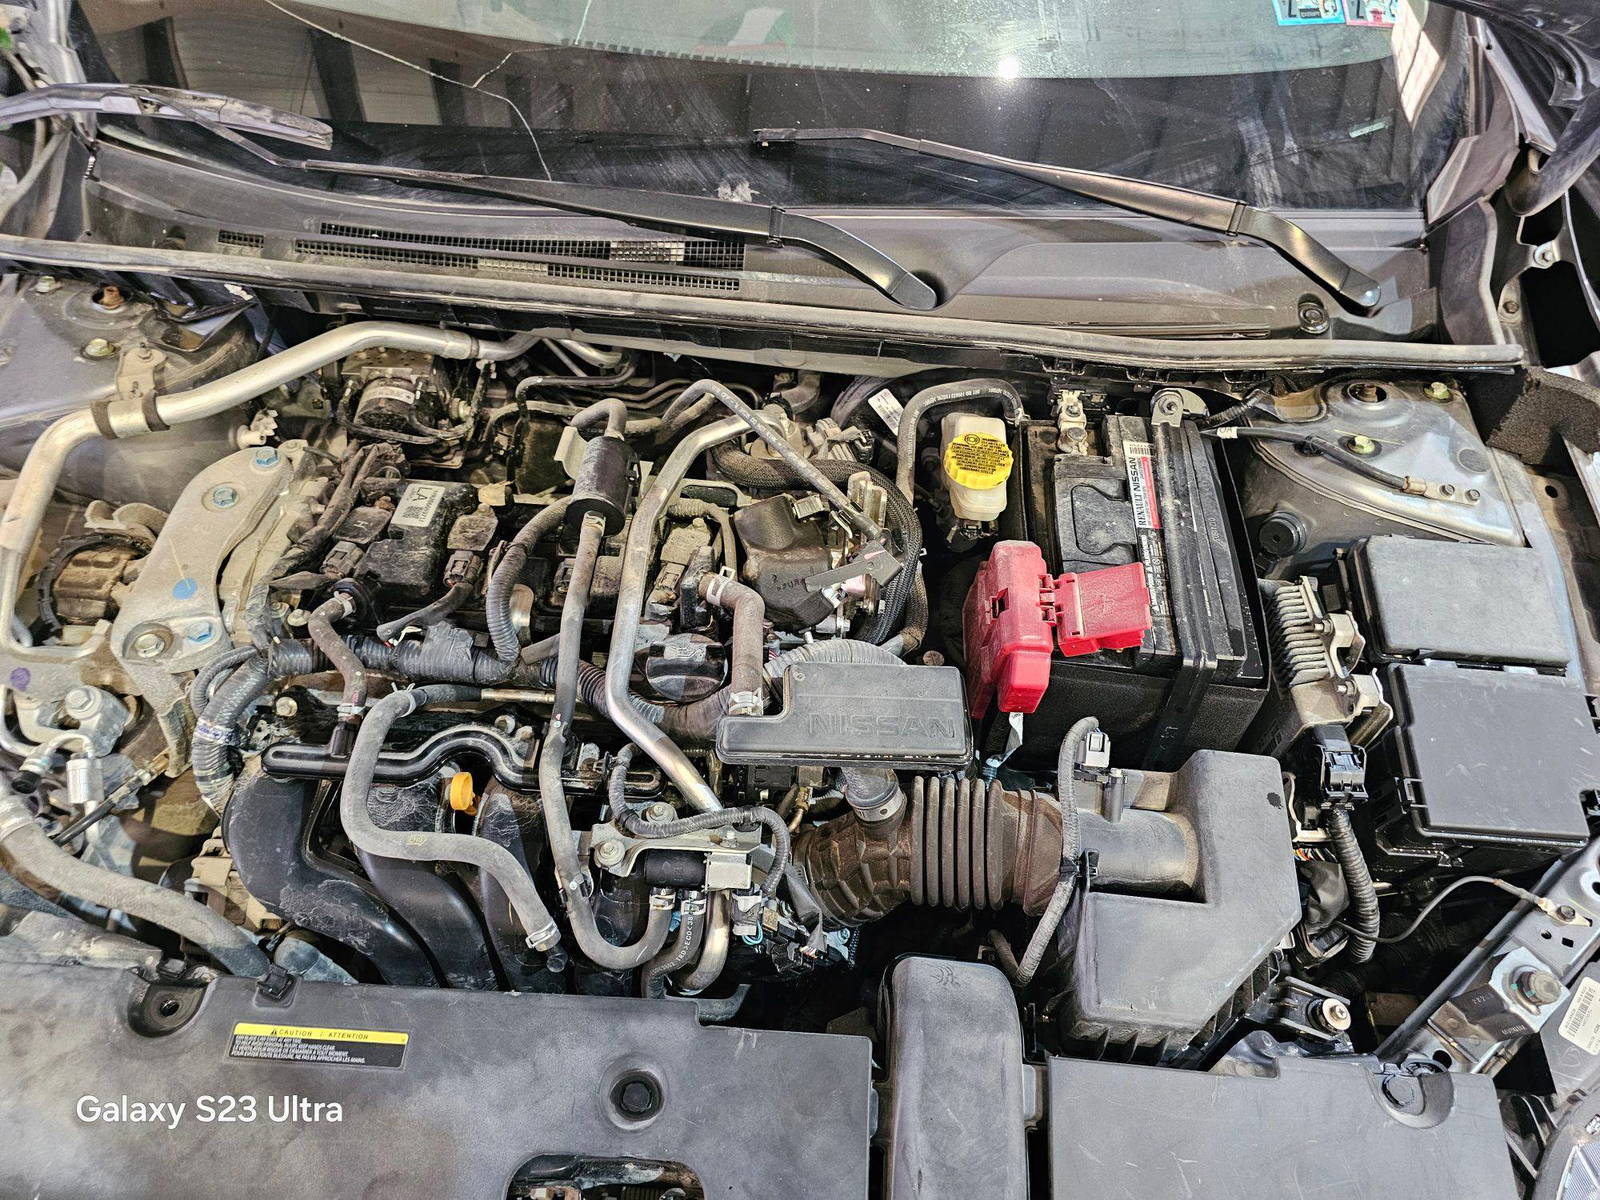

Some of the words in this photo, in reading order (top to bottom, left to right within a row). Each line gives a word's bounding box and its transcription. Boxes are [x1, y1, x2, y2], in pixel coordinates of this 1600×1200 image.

[1129, 456, 1143, 492] NISSAN
[1134, 492, 1147, 526] RENAULT
[808, 712, 955, 738] NISSAN
[278, 1029, 313, 1037] CAUTION
[328, 1031, 369, 1040] ATTENTION
